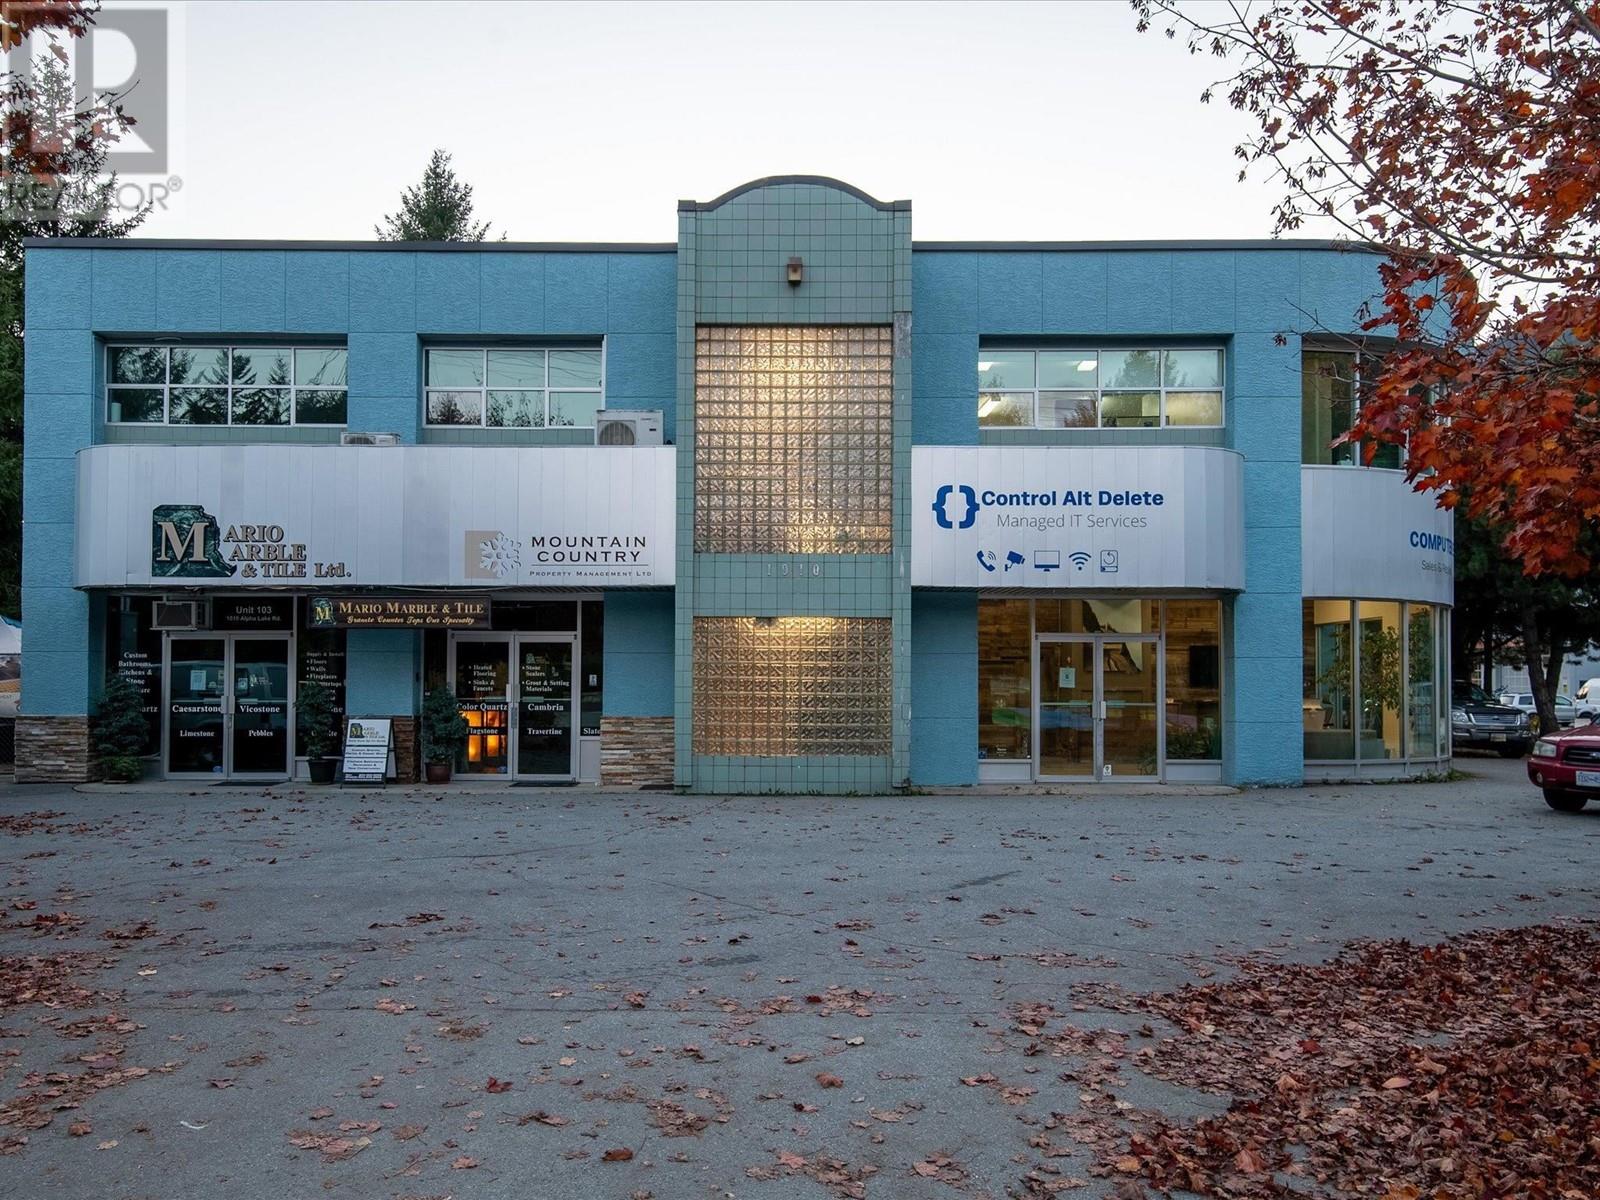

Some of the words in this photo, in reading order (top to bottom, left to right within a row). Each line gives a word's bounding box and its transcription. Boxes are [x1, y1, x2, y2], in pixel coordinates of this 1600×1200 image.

[981, 490, 1057, 506] Control
[1062, 490, 1093, 506] Alt
[1098, 490, 1164, 506] Delete
[997, 513, 1065, 532] Managed
[1070, 514, 1082, 528] IT
[1087, 513, 1148, 528] Services
[532, 536, 647, 548] MOUNTAIN
[537, 551, 641, 563] COUNTRY
[241, 563, 258, 578] &
[261, 563, 307, 578] TILE
[314, 562, 352, 578] Ltd.
[235, 605, 254, 615] Unit
[257, 605, 273, 615] 103
[339, 602, 382, 615] MARIO
[386, 602, 438, 615] MARBLE
[442, 603, 450, 614] &
[454, 602, 484, 615] TILE
[406, 616, 423, 625] Tops
[426, 616, 440, 624] Our
[172, 704, 223, 713] Caesarstone
[240, 704, 280, 713] Vicostone
[456, 703, 477, 711] Color
[480, 703, 508, 712] Quartz
[528, 703, 564, 711] Cambria
[180, 729, 215, 737] Limestone
[249, 729, 273, 737] Pebbles
